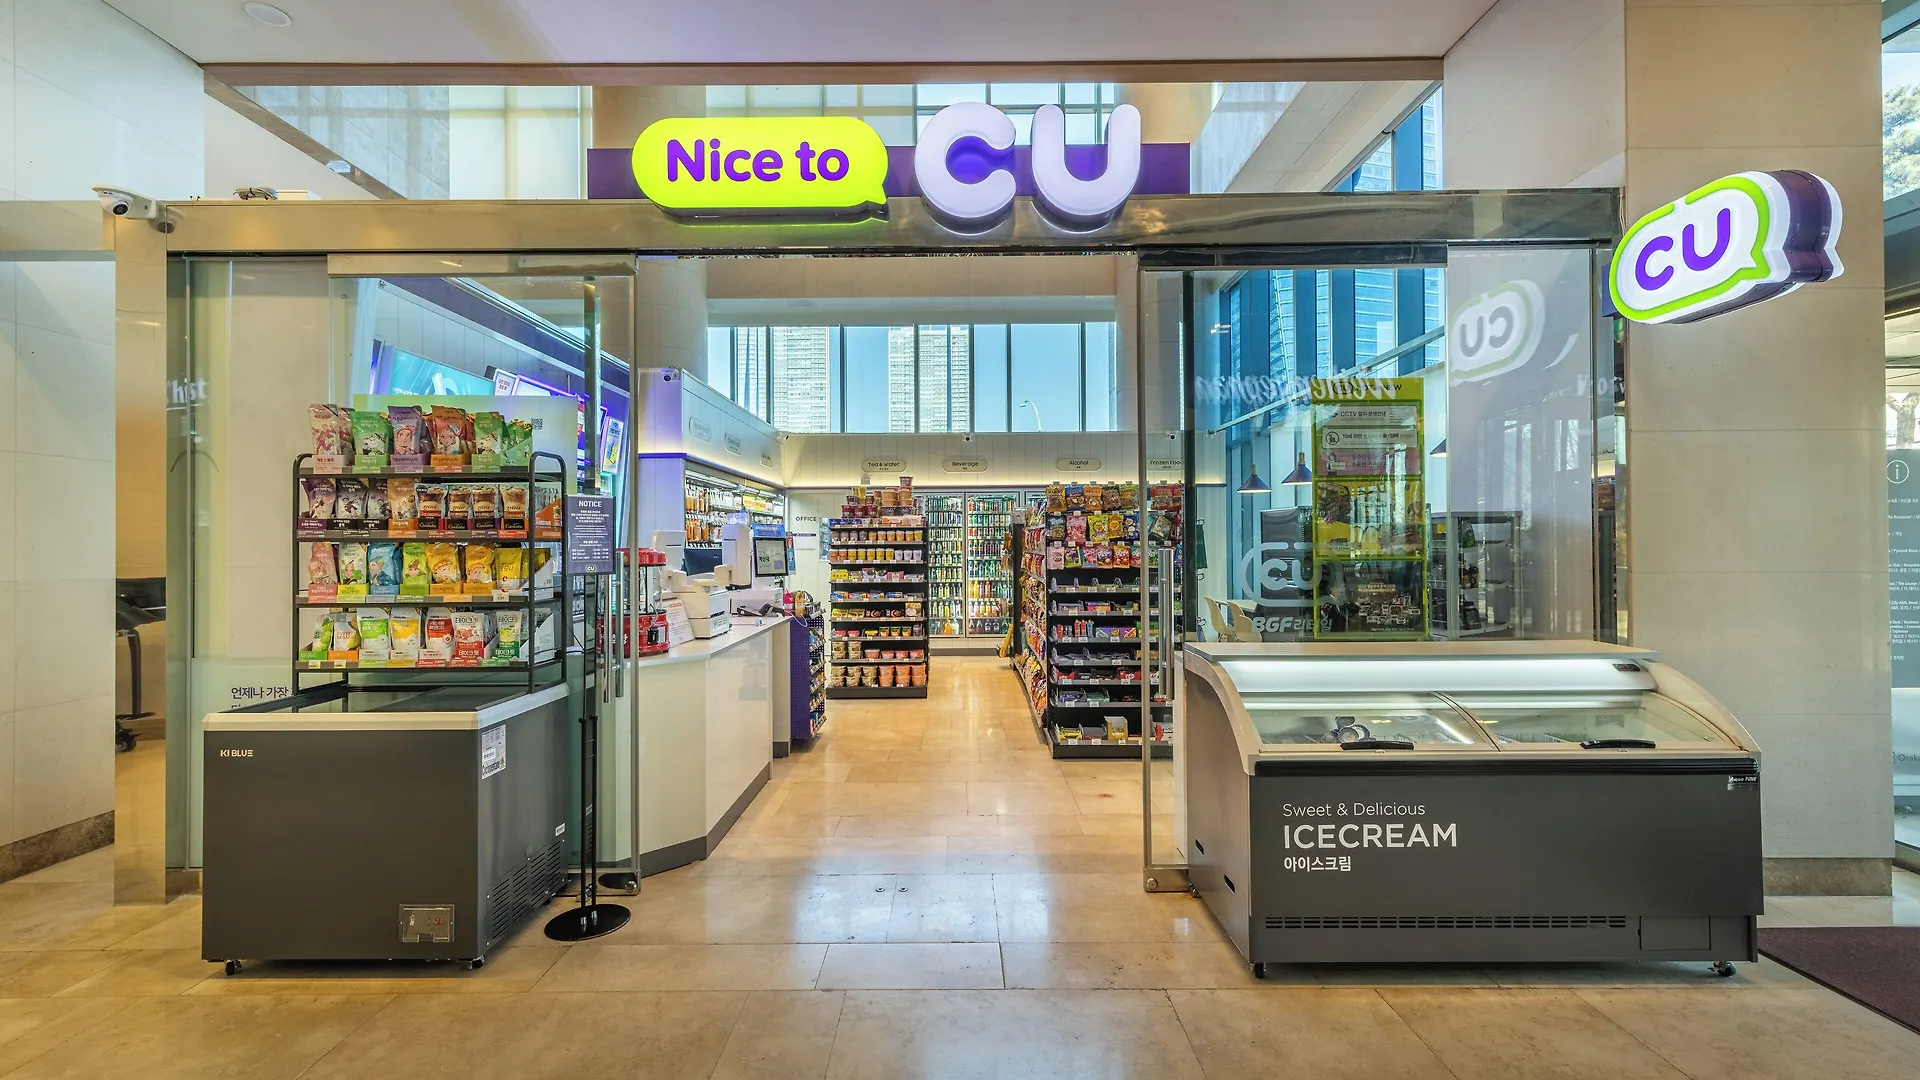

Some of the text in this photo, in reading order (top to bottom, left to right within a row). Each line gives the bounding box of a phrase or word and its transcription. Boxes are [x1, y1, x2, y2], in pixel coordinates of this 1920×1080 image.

[667, 138, 850, 182] Nice to
[914, 101, 1141, 218] CU
[1634, 207, 1731, 291] CU
[578, 500, 602, 508] NOTICE
[1261, 558, 1323, 590] CU
[231, 686, 289, 700] 언제나 가장
[220, 749, 254, 757] KI BLUE
[1282, 802, 1426, 818] Sweet & Delicious
[1282, 823, 1458, 850] ICECREAM
[1283, 855, 1352, 873] 아이스크림
